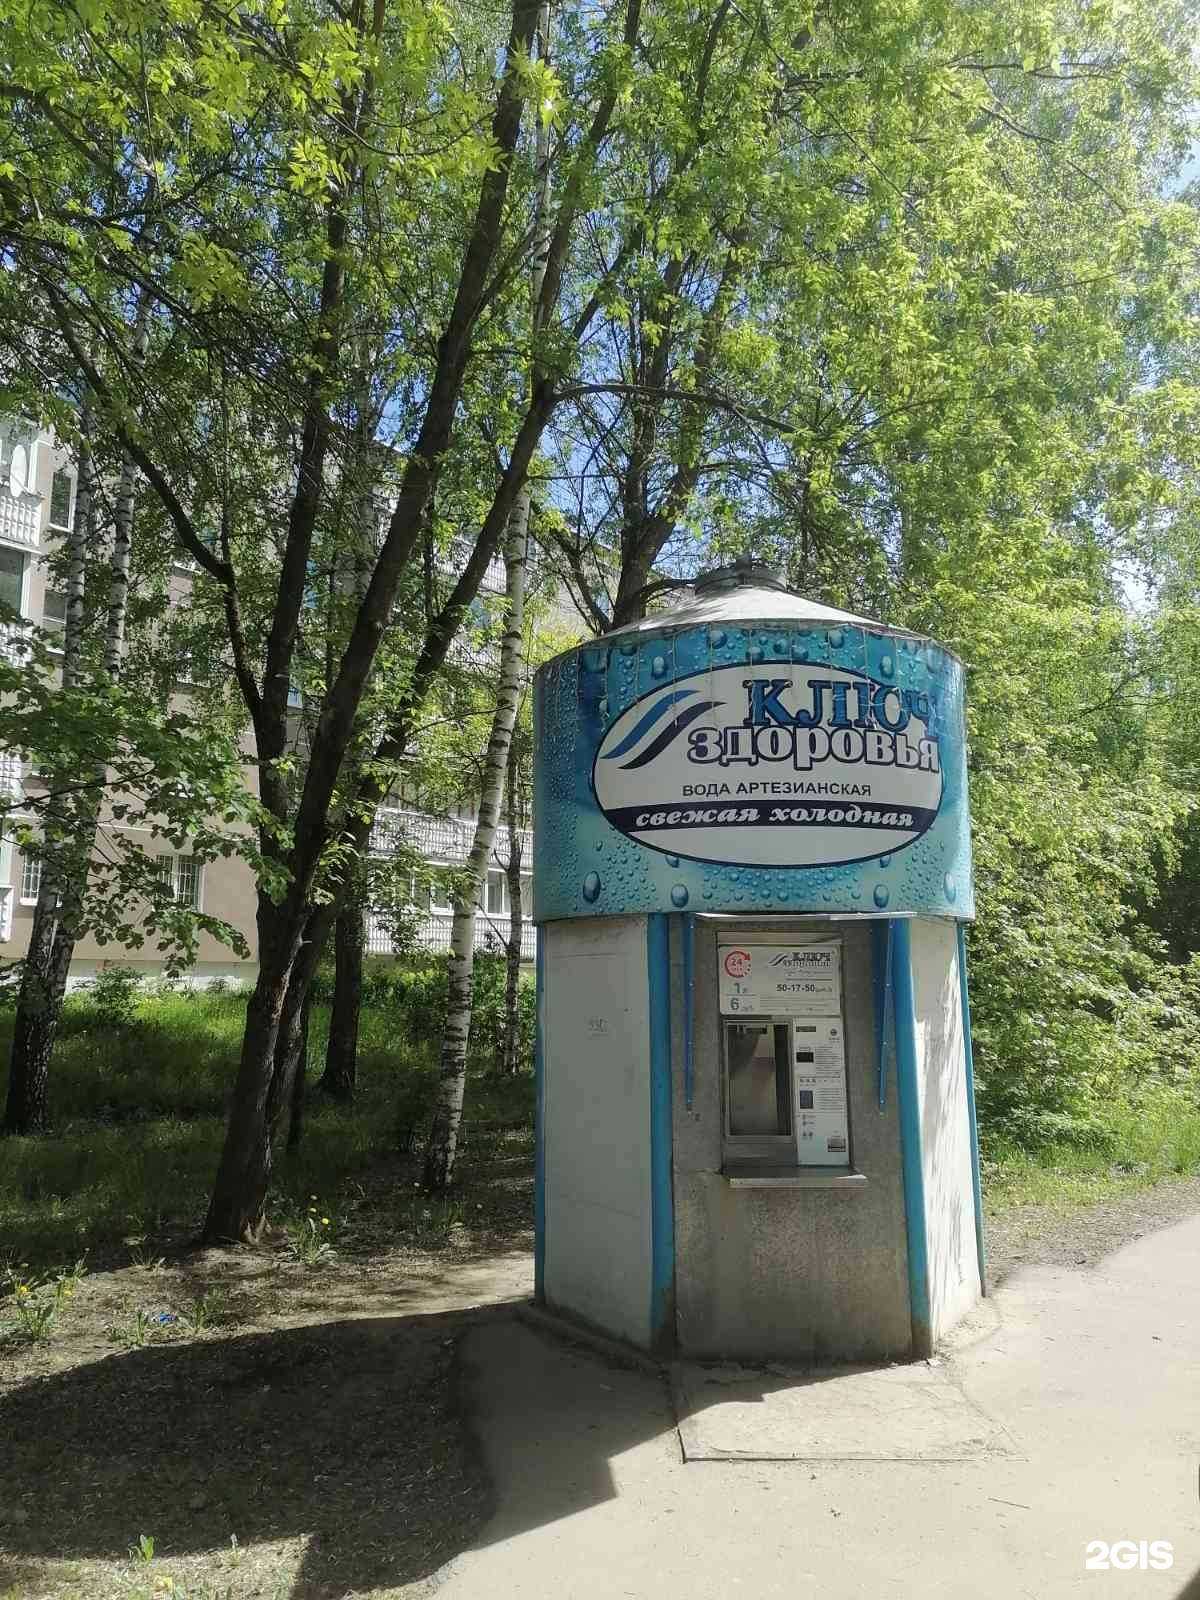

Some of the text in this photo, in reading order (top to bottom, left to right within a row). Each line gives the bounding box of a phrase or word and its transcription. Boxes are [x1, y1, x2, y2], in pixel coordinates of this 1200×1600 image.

[743, 679, 938, 736] КЛЮЧ
[682, 781, 872, 798] ВОДА АРТЕЗИАНСКАЯ
[635, 803, 915, 828] свежая холодная
[731, 957, 743, 967] 24
[775, 984, 815, 993] 50-17-50
[730, 998, 740, 1011] 6
